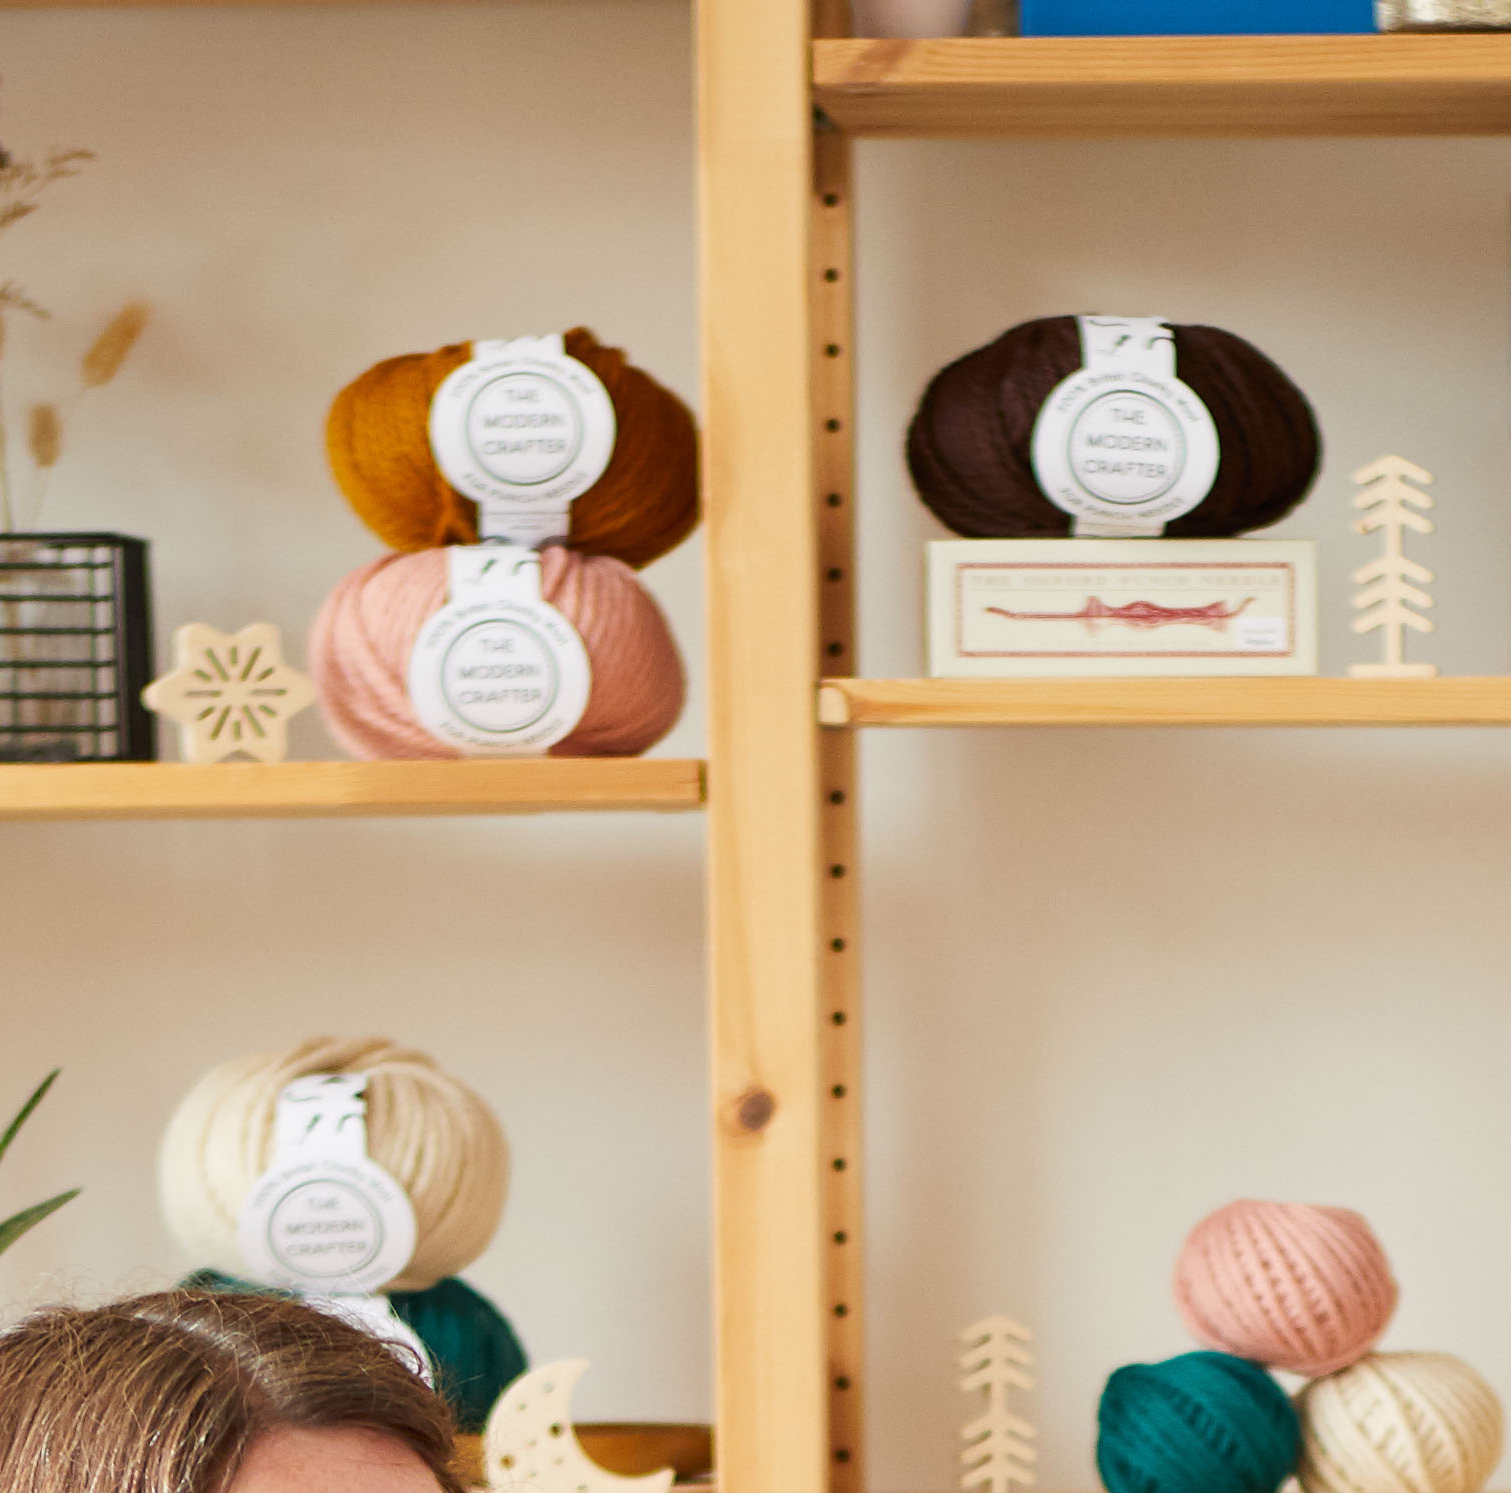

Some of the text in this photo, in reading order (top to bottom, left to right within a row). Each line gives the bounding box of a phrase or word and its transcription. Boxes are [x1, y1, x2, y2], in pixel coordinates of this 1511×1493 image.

[482, 413, 565, 429] MODERN
[1112, 408, 1146, 425] THE
[483, 438, 566, 456] CRAFTER
[1086, 433, 1168, 452] MODERN
[1084, 458, 1171, 480] CRAFTER
[459, 664, 542, 680] MODERN
[457, 688, 542, 705] CRAFTER
